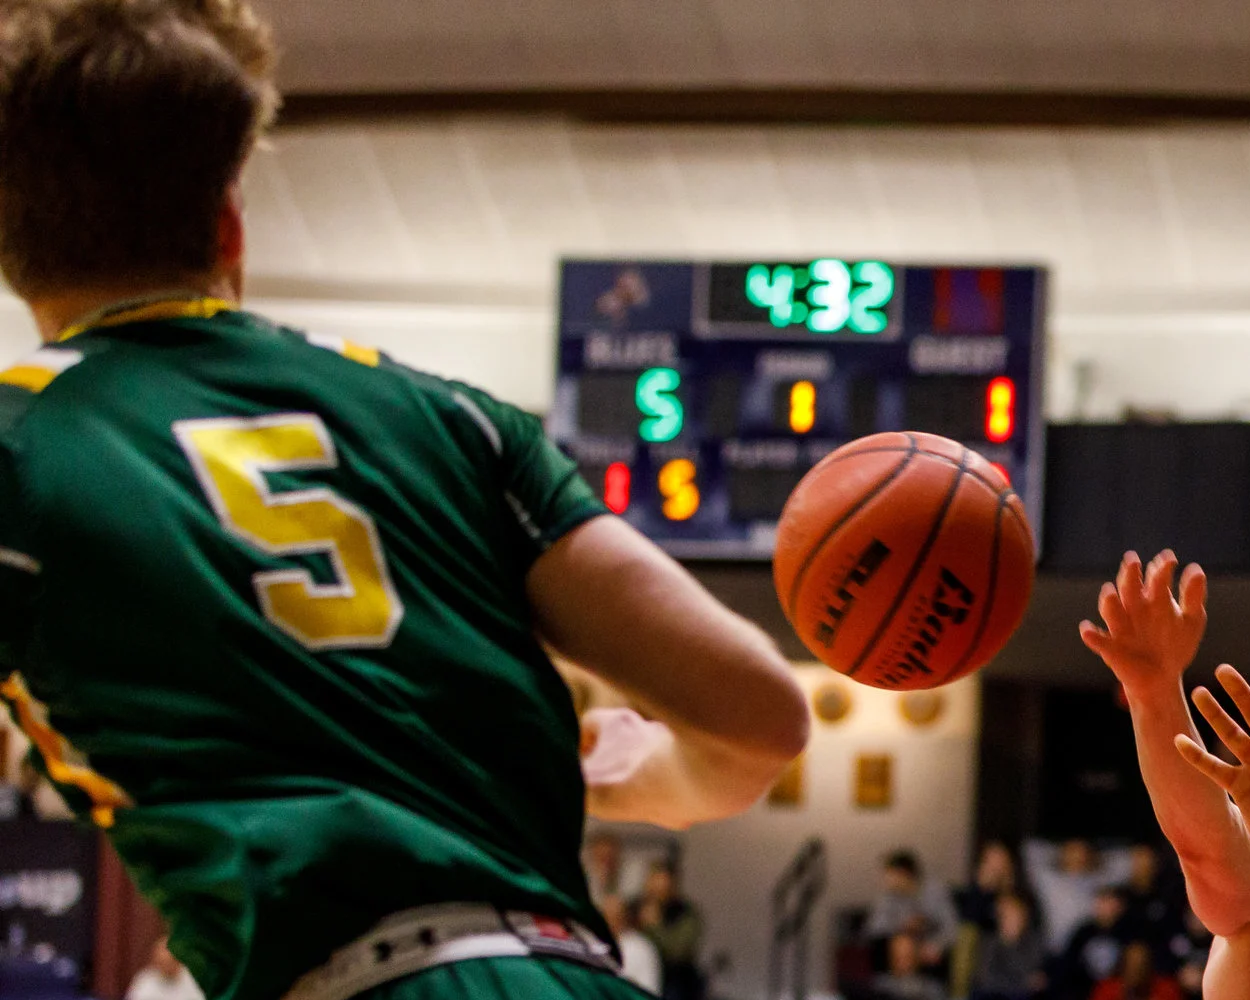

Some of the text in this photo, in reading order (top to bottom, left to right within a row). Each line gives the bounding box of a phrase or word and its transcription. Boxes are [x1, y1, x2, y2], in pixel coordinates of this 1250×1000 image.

[745, 258, 894, 333] 4:32
[171, 412, 405, 651] 5
[814, 537, 891, 649] ELITE
